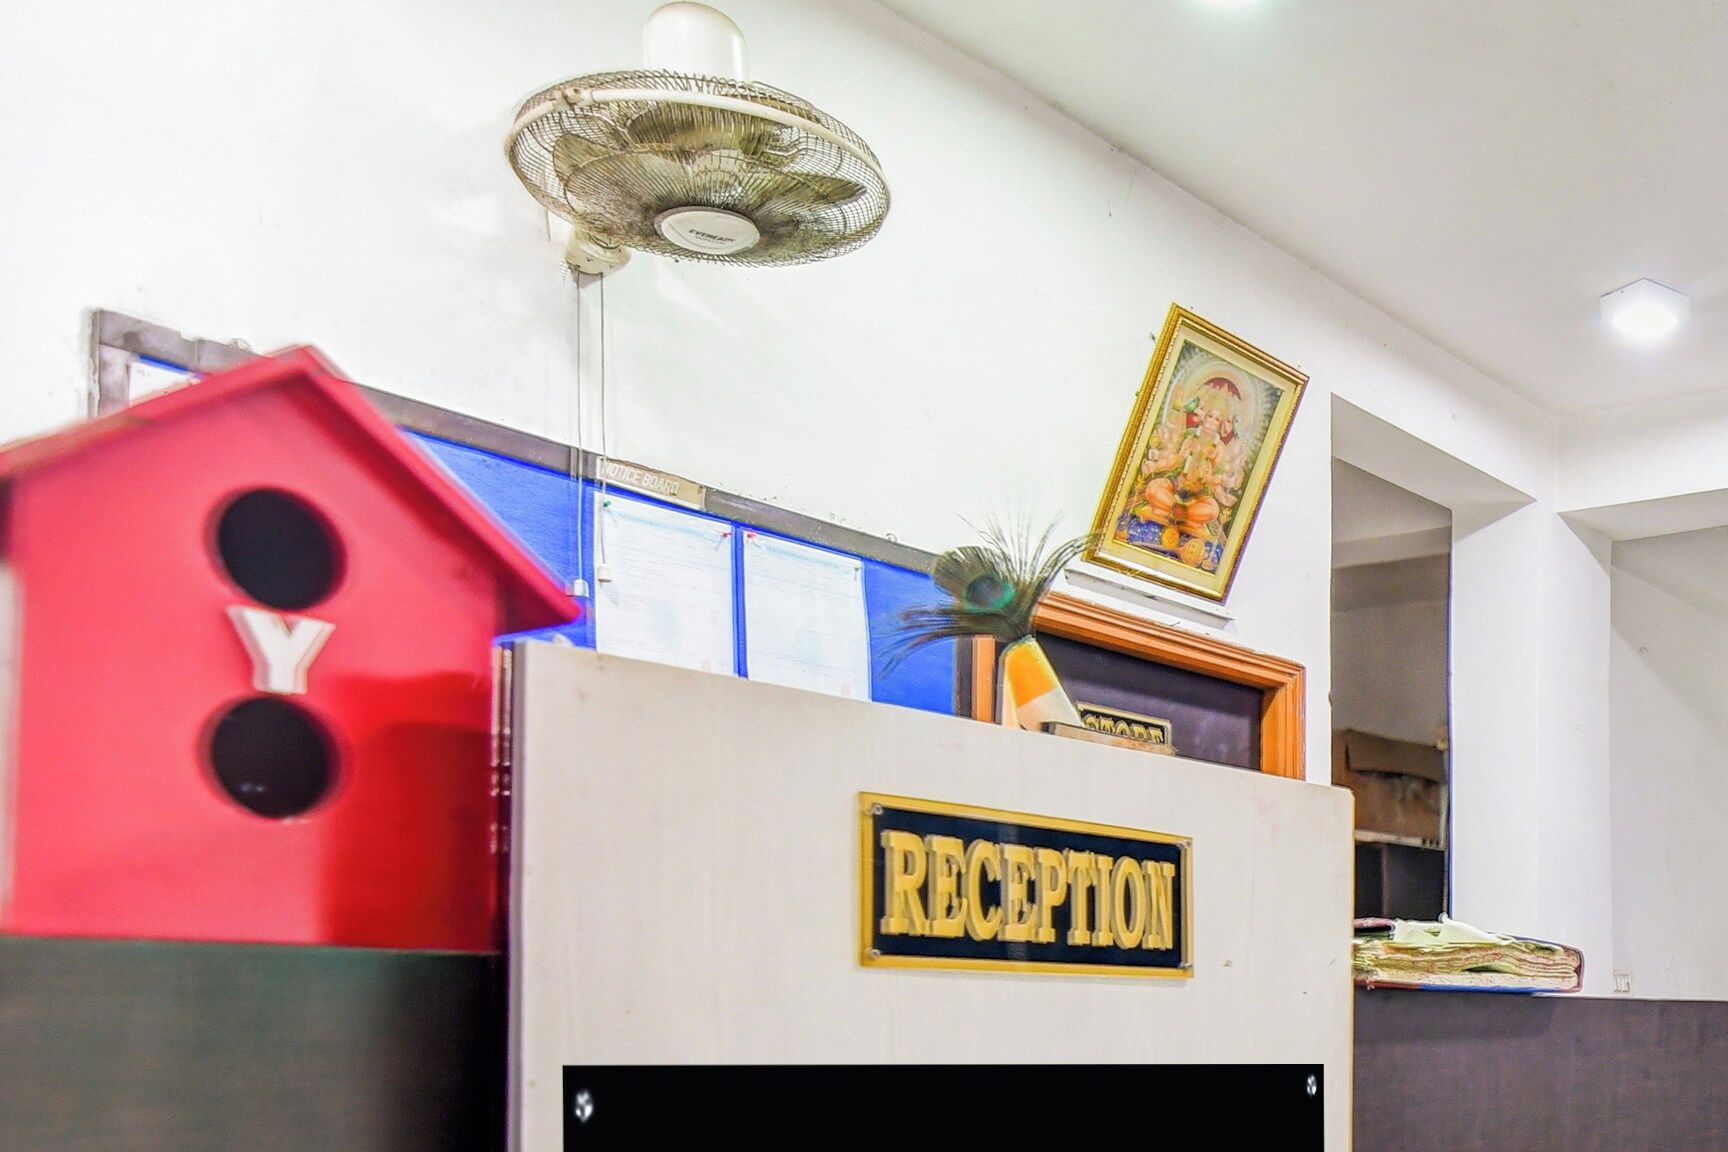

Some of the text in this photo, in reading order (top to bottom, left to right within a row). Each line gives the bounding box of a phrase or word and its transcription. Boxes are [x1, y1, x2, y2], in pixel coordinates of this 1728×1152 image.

[688, 228, 736, 242] EVEREADY
[602, 462, 681, 494] NOTICE BOARD
[880, 829, 1176, 951] RECEPTION
